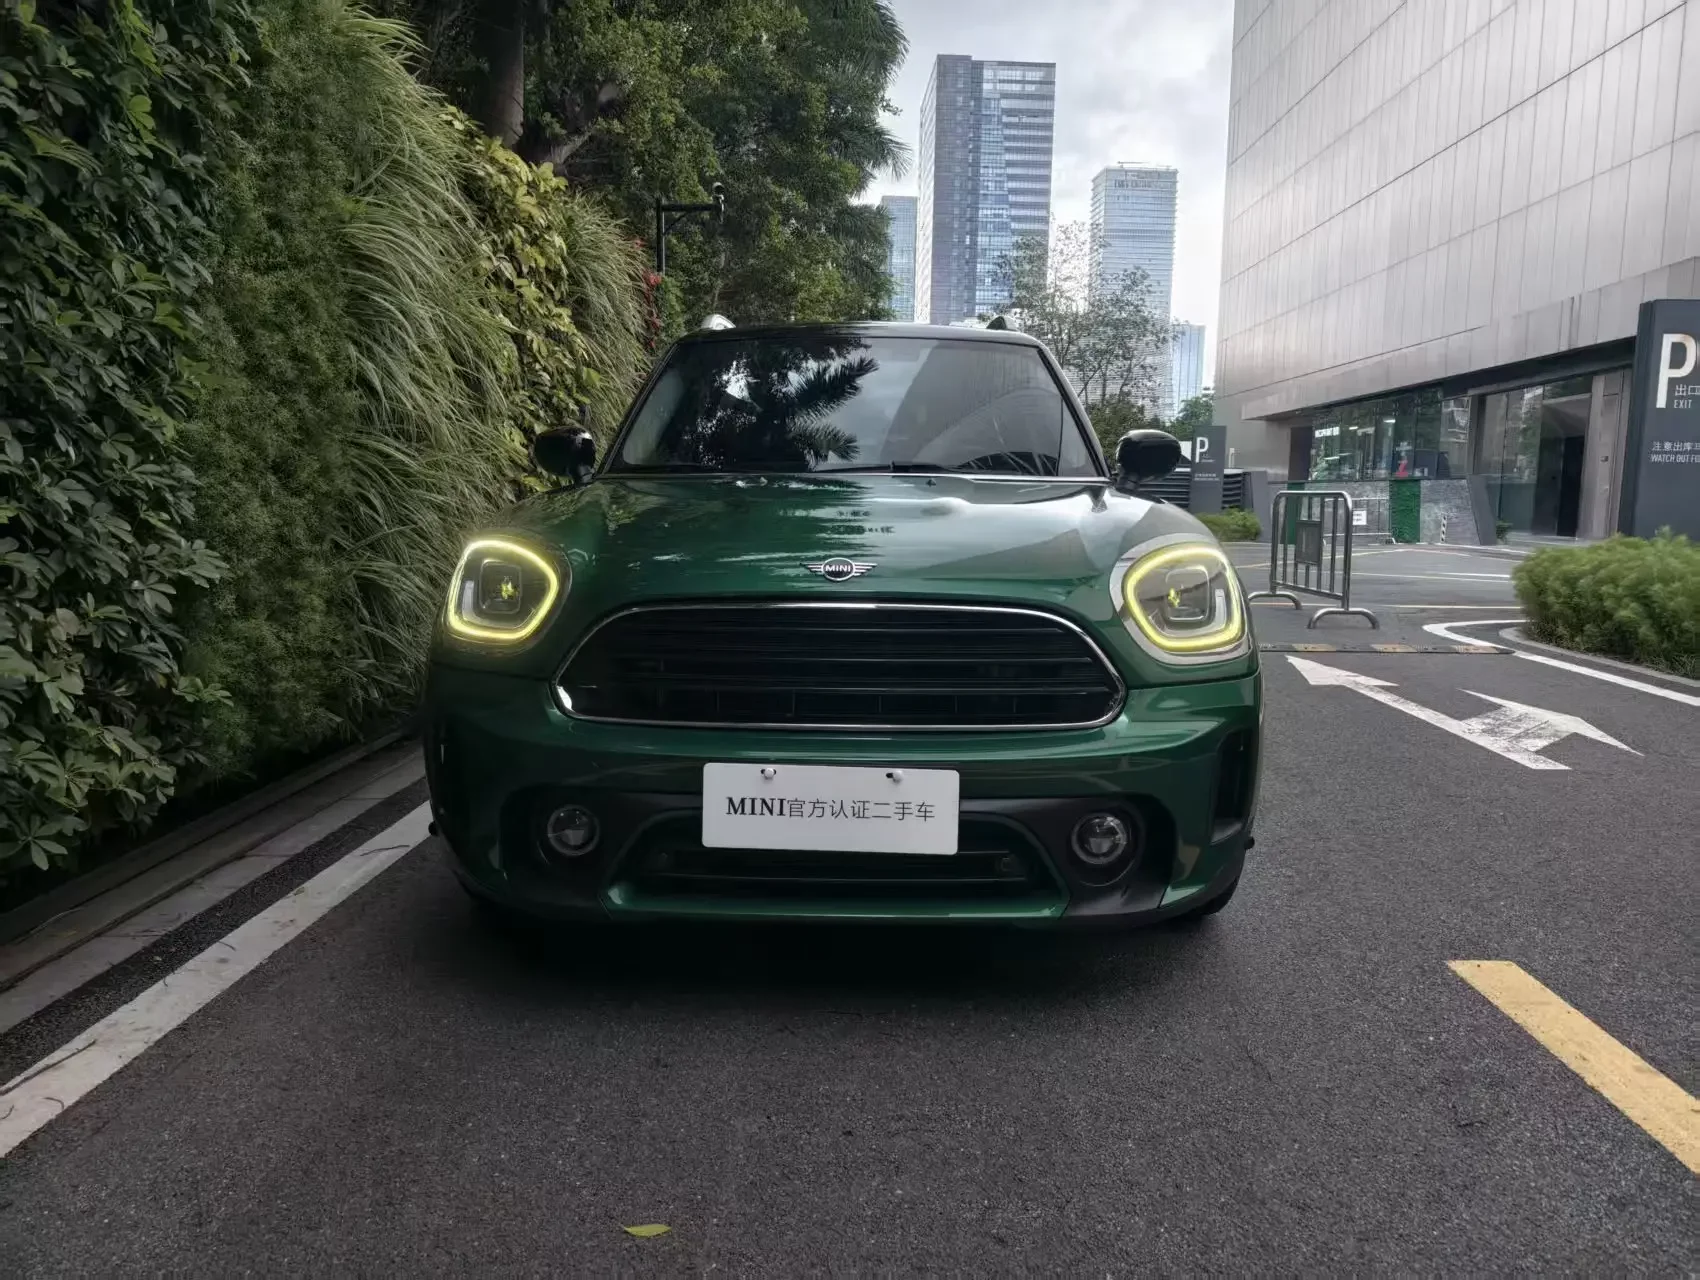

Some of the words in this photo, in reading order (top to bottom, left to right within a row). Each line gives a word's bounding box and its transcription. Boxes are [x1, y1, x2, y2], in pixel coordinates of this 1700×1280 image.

[1656, 333, 1697, 409] P
[1673, 399, 1692, 409] EXIT
[1195, 436, 1209, 463] P
[1651, 453, 1675, 463] WATCH
[1676, 454, 1689, 463] OUT
[825, 564, 851, 573] MINI
